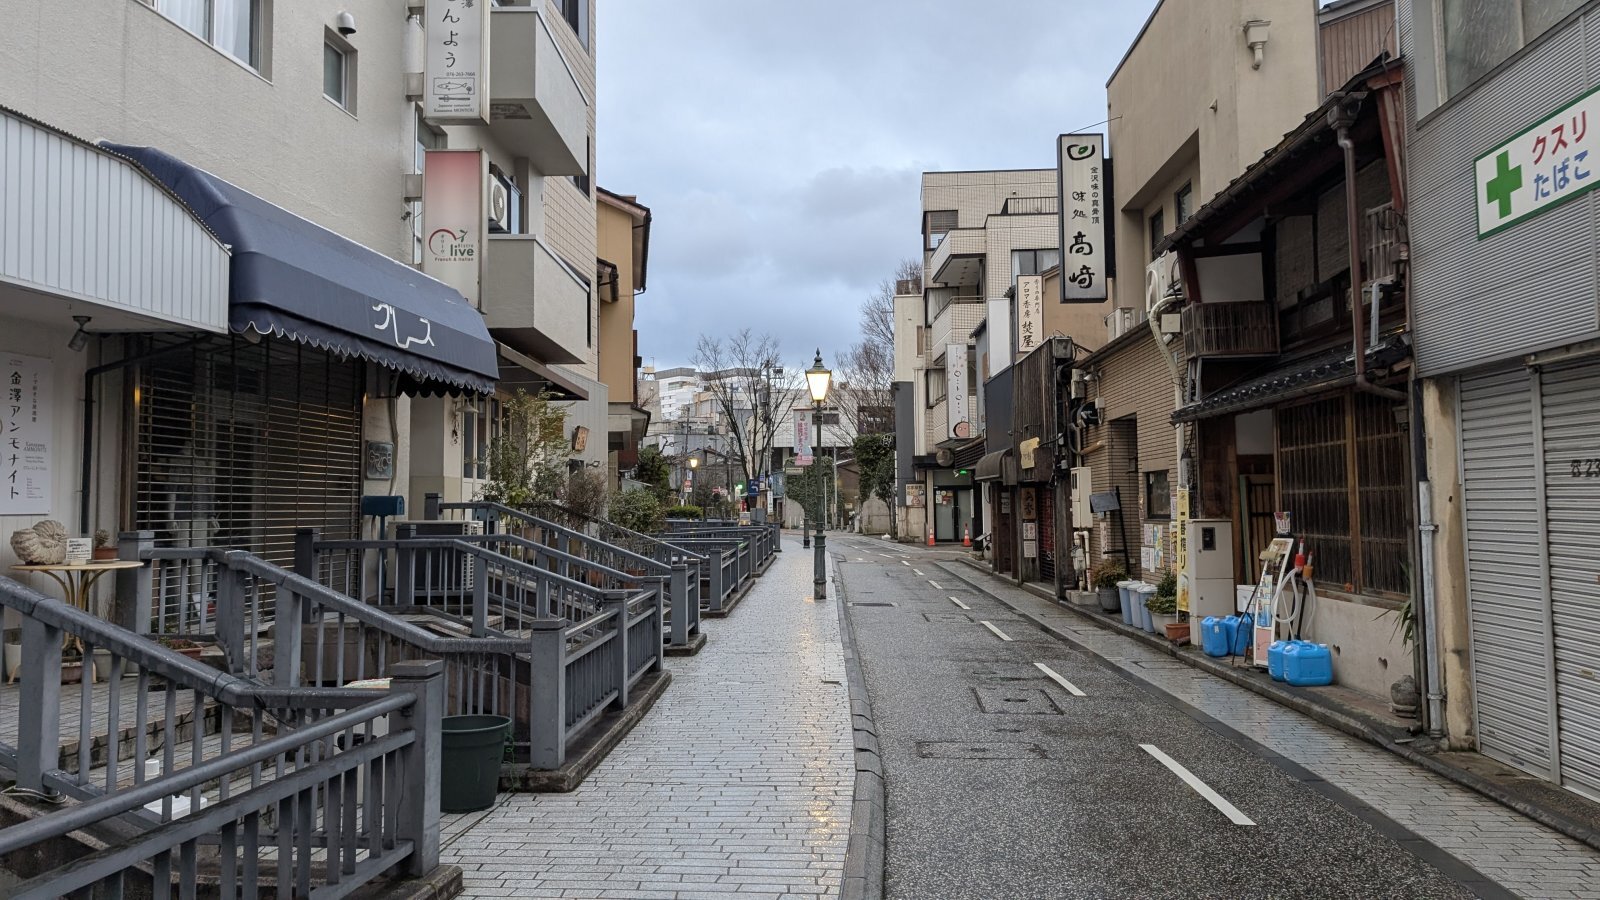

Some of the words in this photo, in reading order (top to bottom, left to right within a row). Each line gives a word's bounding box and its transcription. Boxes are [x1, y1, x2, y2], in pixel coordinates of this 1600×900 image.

[442, 0, 460, 68] んよう
[1532, 110, 1587, 166] クスリ
[1090, 166, 1100, 225] 金沢味の真骨頂
[1533, 149, 1591, 202] たばこ
[8, 371, 22, 500] 金澤アンモナイト
